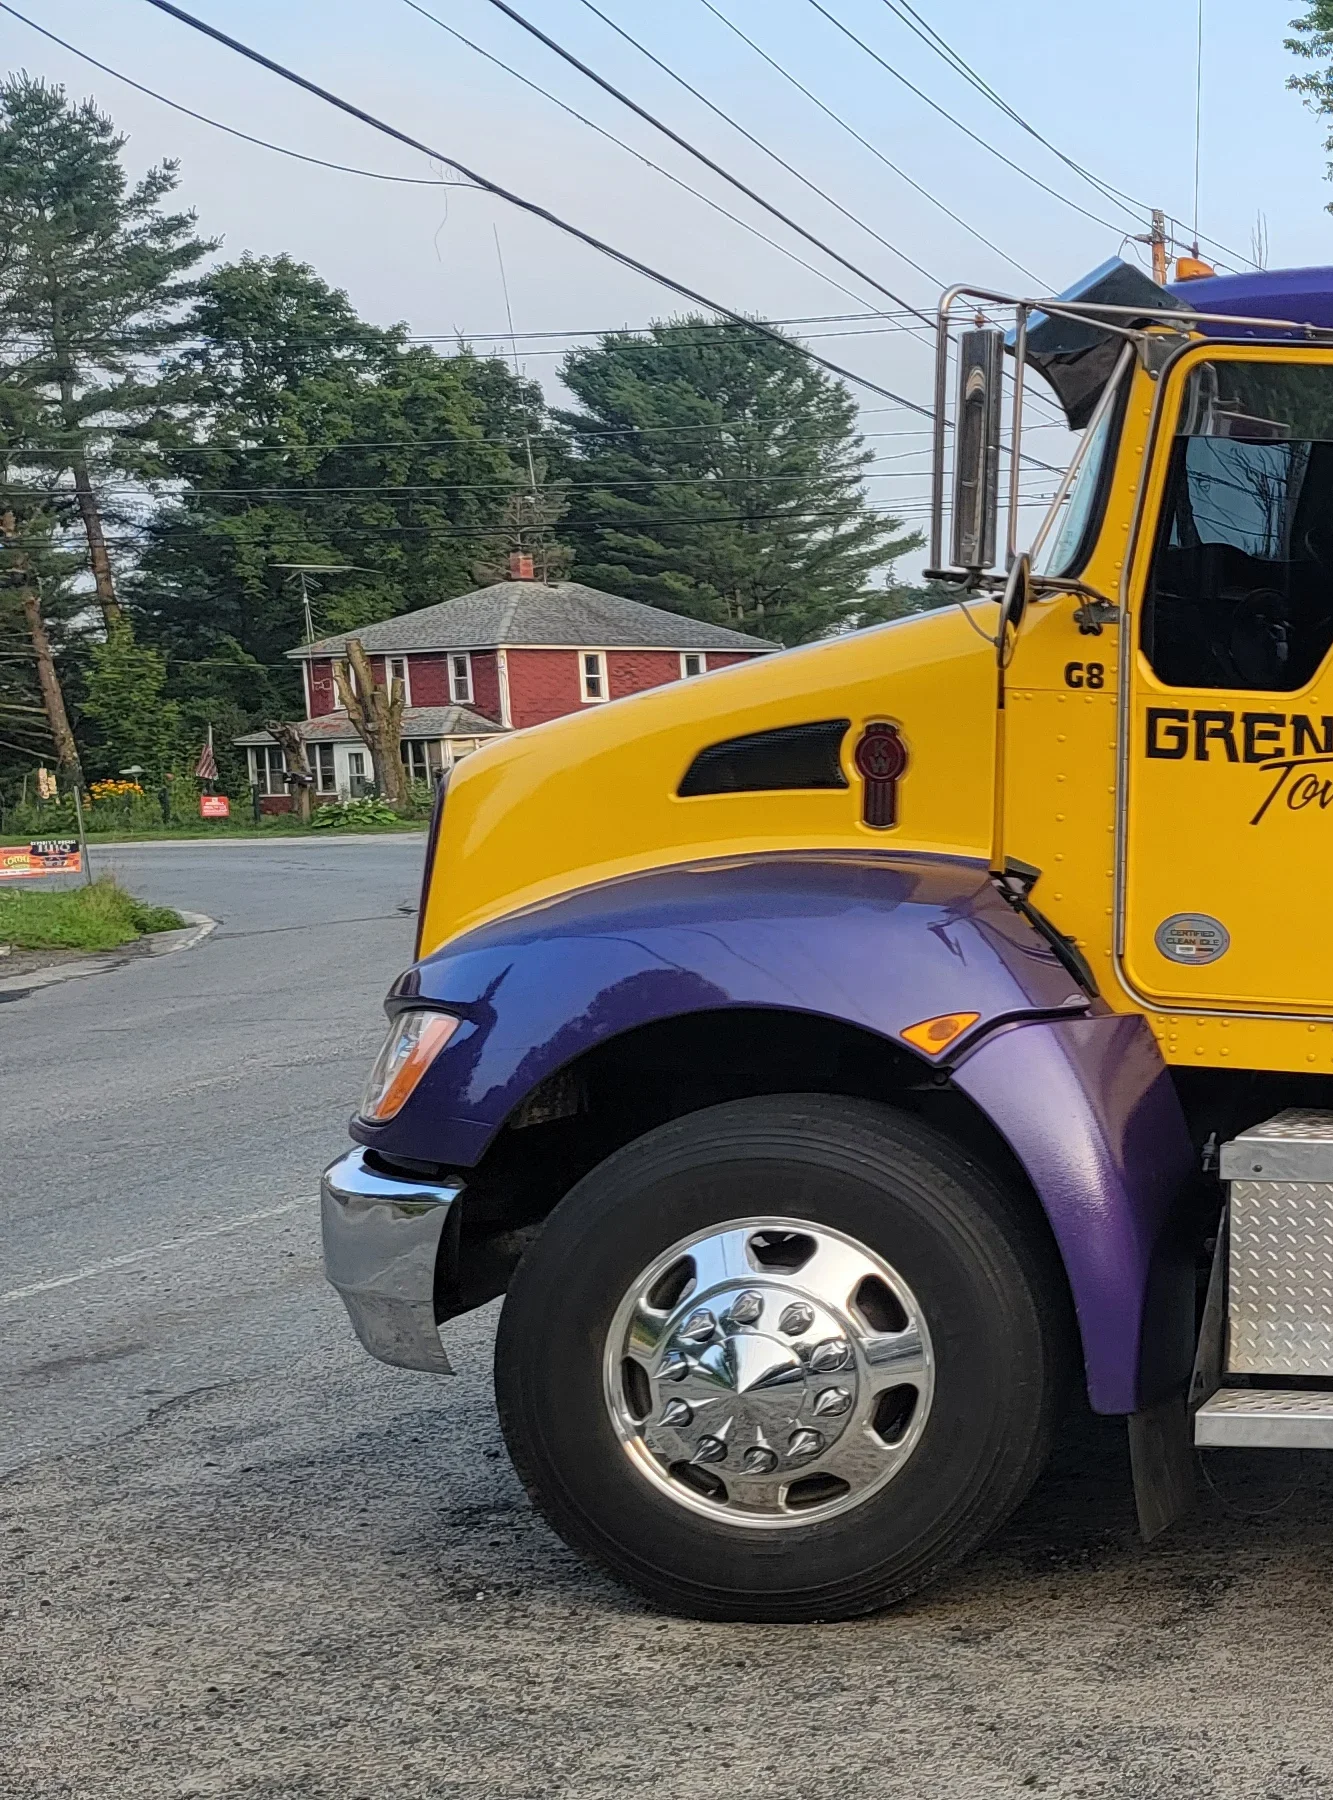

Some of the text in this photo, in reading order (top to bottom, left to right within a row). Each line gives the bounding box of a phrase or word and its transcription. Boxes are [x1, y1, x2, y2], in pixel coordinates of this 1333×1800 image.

[1064, 661, 1105, 690] G8
[1170, 929, 1215, 938] CERTIFIED
[1166, 937, 1196, 945] CLEAN
